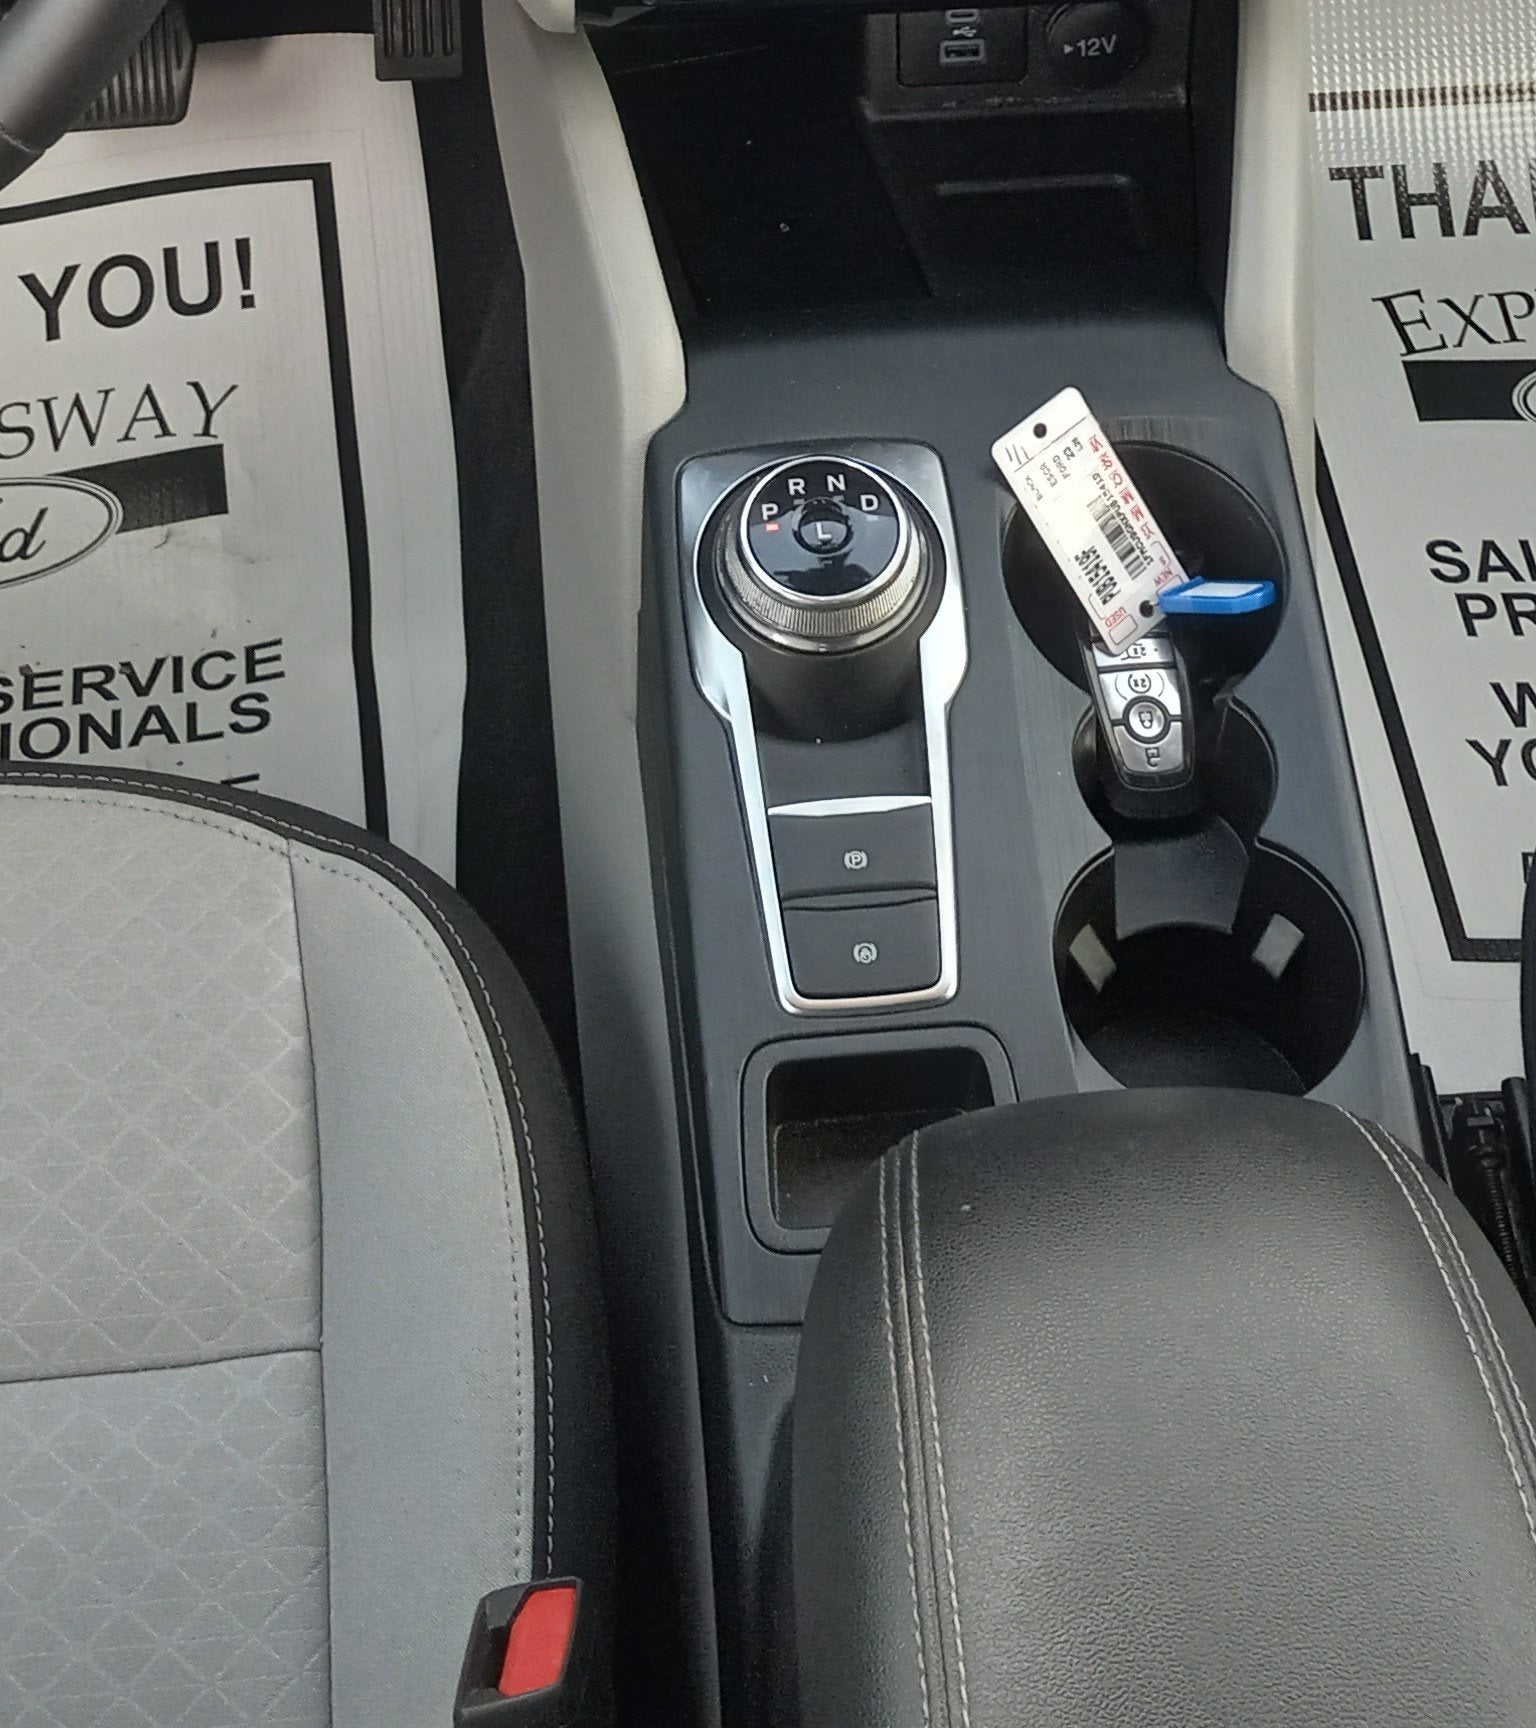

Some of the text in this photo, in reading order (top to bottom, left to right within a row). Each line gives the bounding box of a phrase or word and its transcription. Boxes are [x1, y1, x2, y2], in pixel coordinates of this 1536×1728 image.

[1076, 34, 1117, 57] 12V
[19, 237, 256, 342] YOU!
[787, 477, 806, 496] R
[826, 473, 847, 492] N
[761, 503, 779, 521] P
[860, 494, 879, 511] D
[815, 522, 833, 539] L
[1104, 606, 1127, 628] USED
